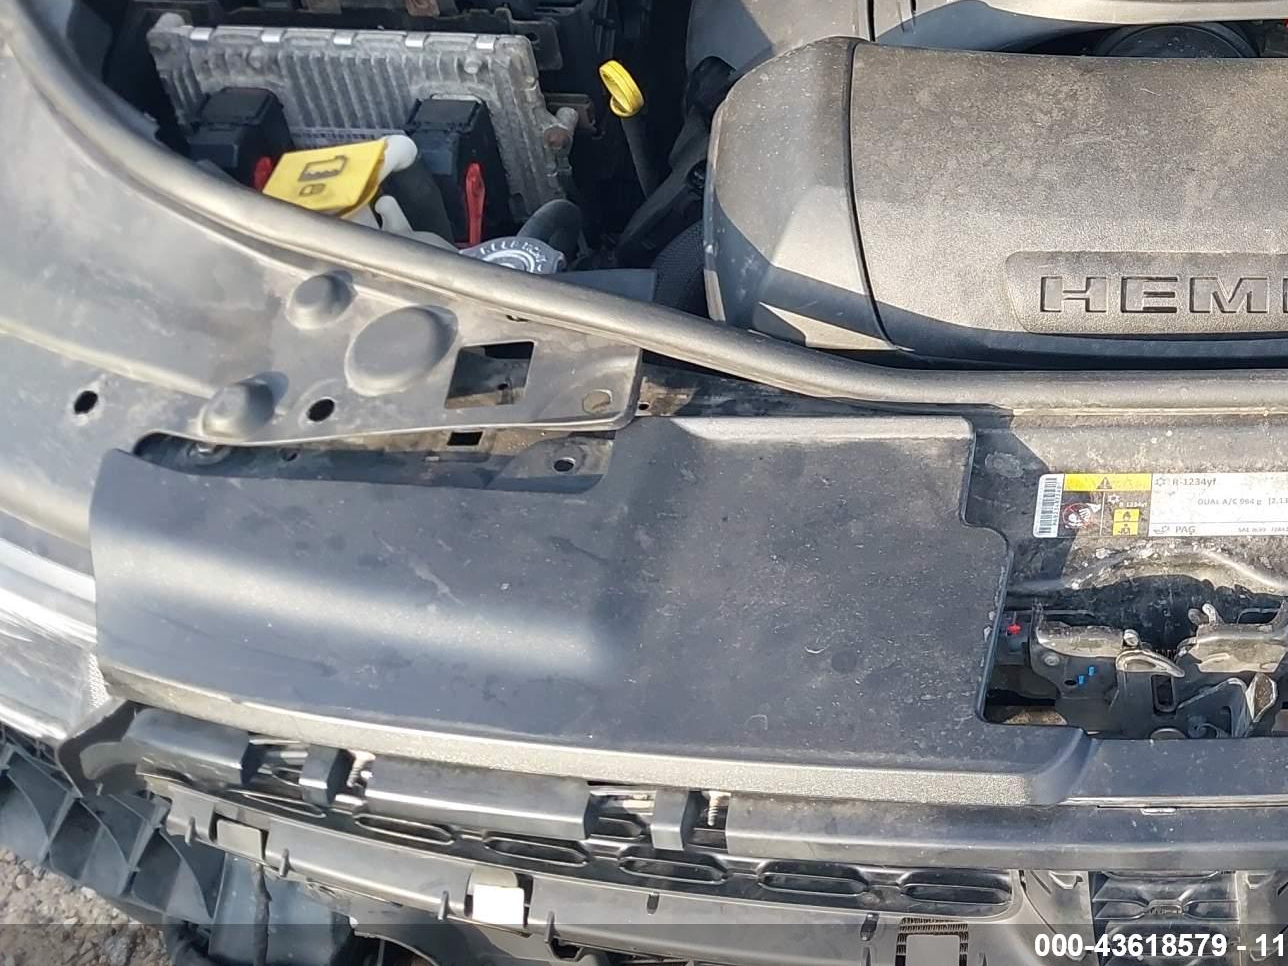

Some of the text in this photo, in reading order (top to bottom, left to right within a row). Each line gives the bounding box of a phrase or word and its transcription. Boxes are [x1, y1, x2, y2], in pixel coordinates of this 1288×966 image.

[1172, 477, 1217, 488] R-1234yf
[1197, 497, 1220, 505] DUAL
[1222, 497, 1238, 505] A/C
[1175, 525, 1196, 534] PAG
